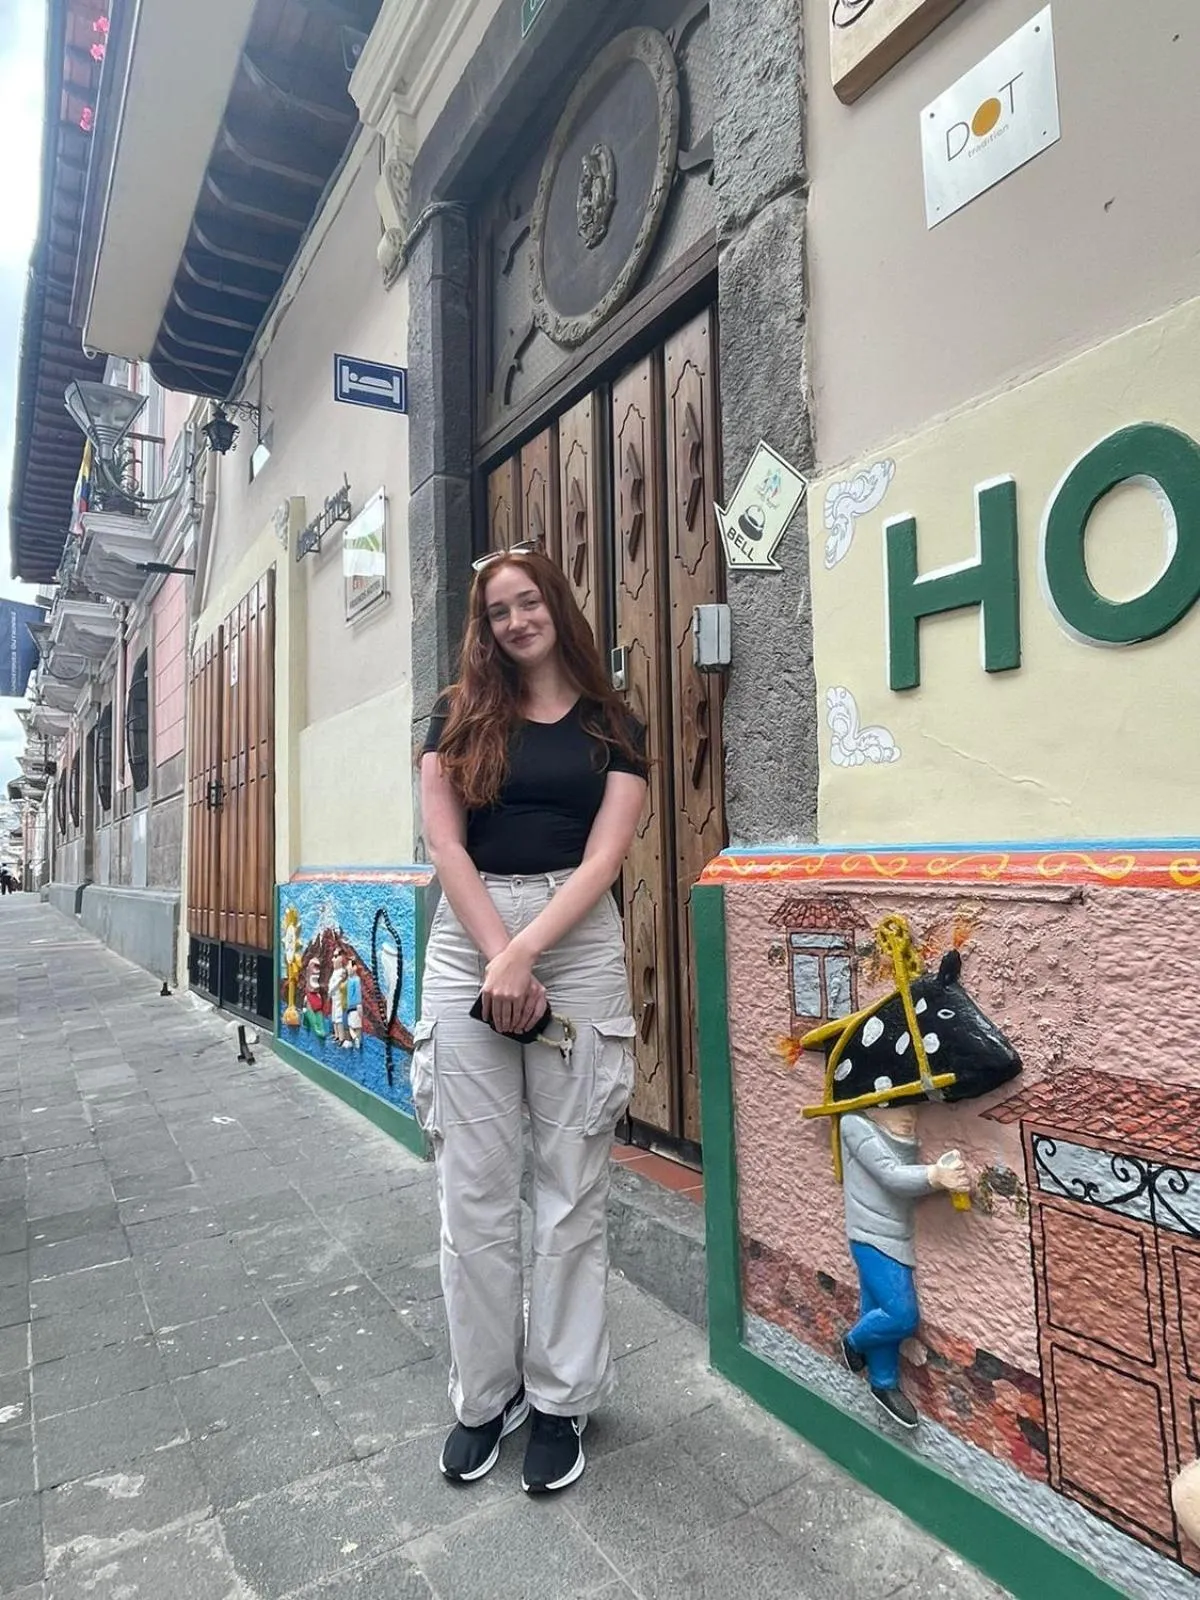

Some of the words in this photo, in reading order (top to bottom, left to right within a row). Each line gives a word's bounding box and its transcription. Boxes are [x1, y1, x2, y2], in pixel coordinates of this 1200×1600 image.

[946, 71, 1024, 162] DOT
[967, 123, 1010, 158] tradition
[726, 527, 754, 562] BELL
[882, 420, 1200, 693] HO
